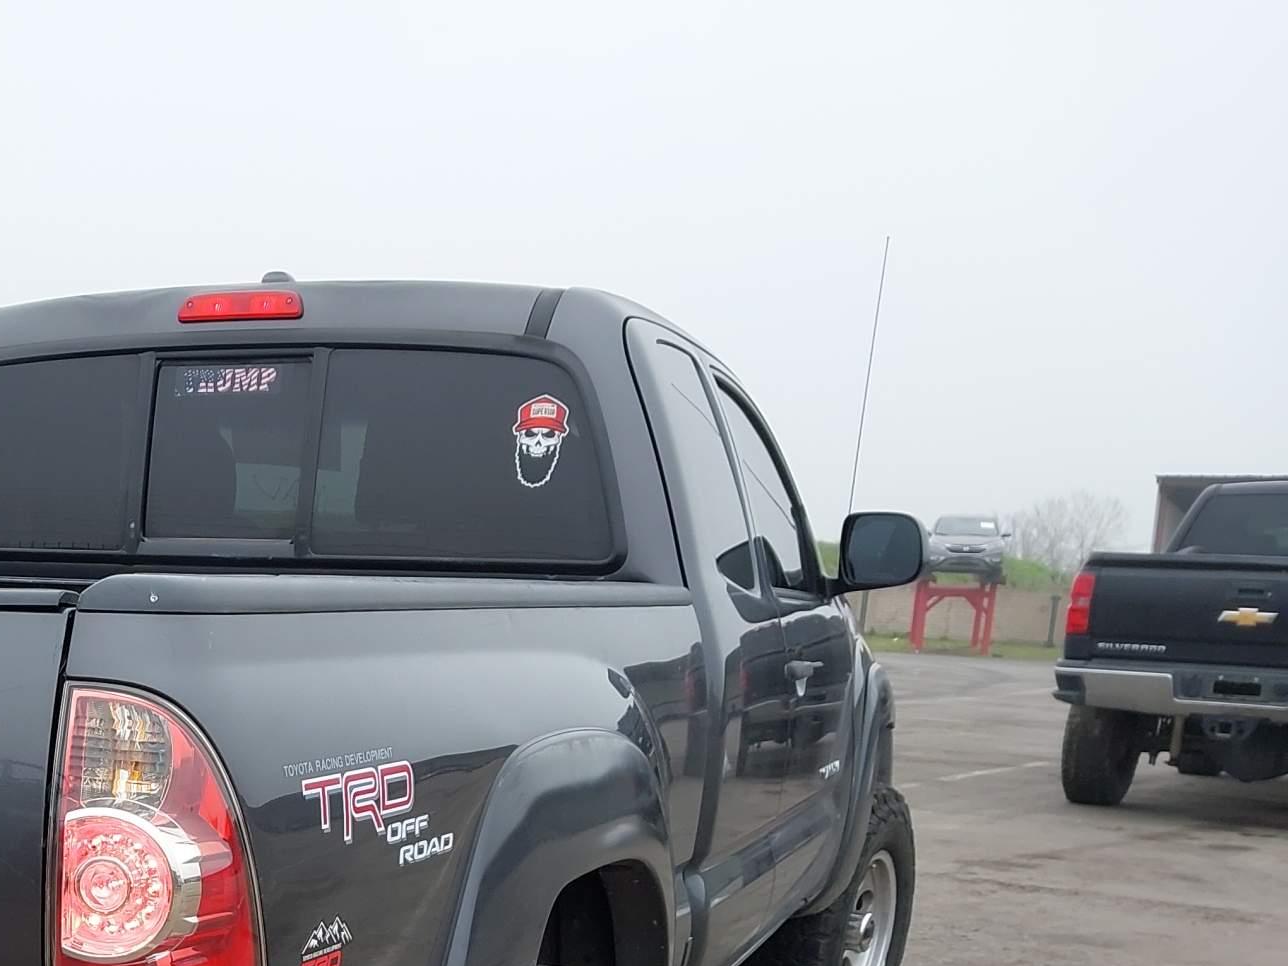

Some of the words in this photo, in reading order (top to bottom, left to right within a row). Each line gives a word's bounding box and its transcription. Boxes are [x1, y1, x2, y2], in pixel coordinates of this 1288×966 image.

[283, 763, 314, 777] TOYOTA
[315, 755, 344, 771] RACING
[344, 747, 393, 766] DEVELOPMENT
[302, 760, 415, 844] TRD
[386, 814, 430, 844] OFF
[398, 832, 455, 867] ROAD
